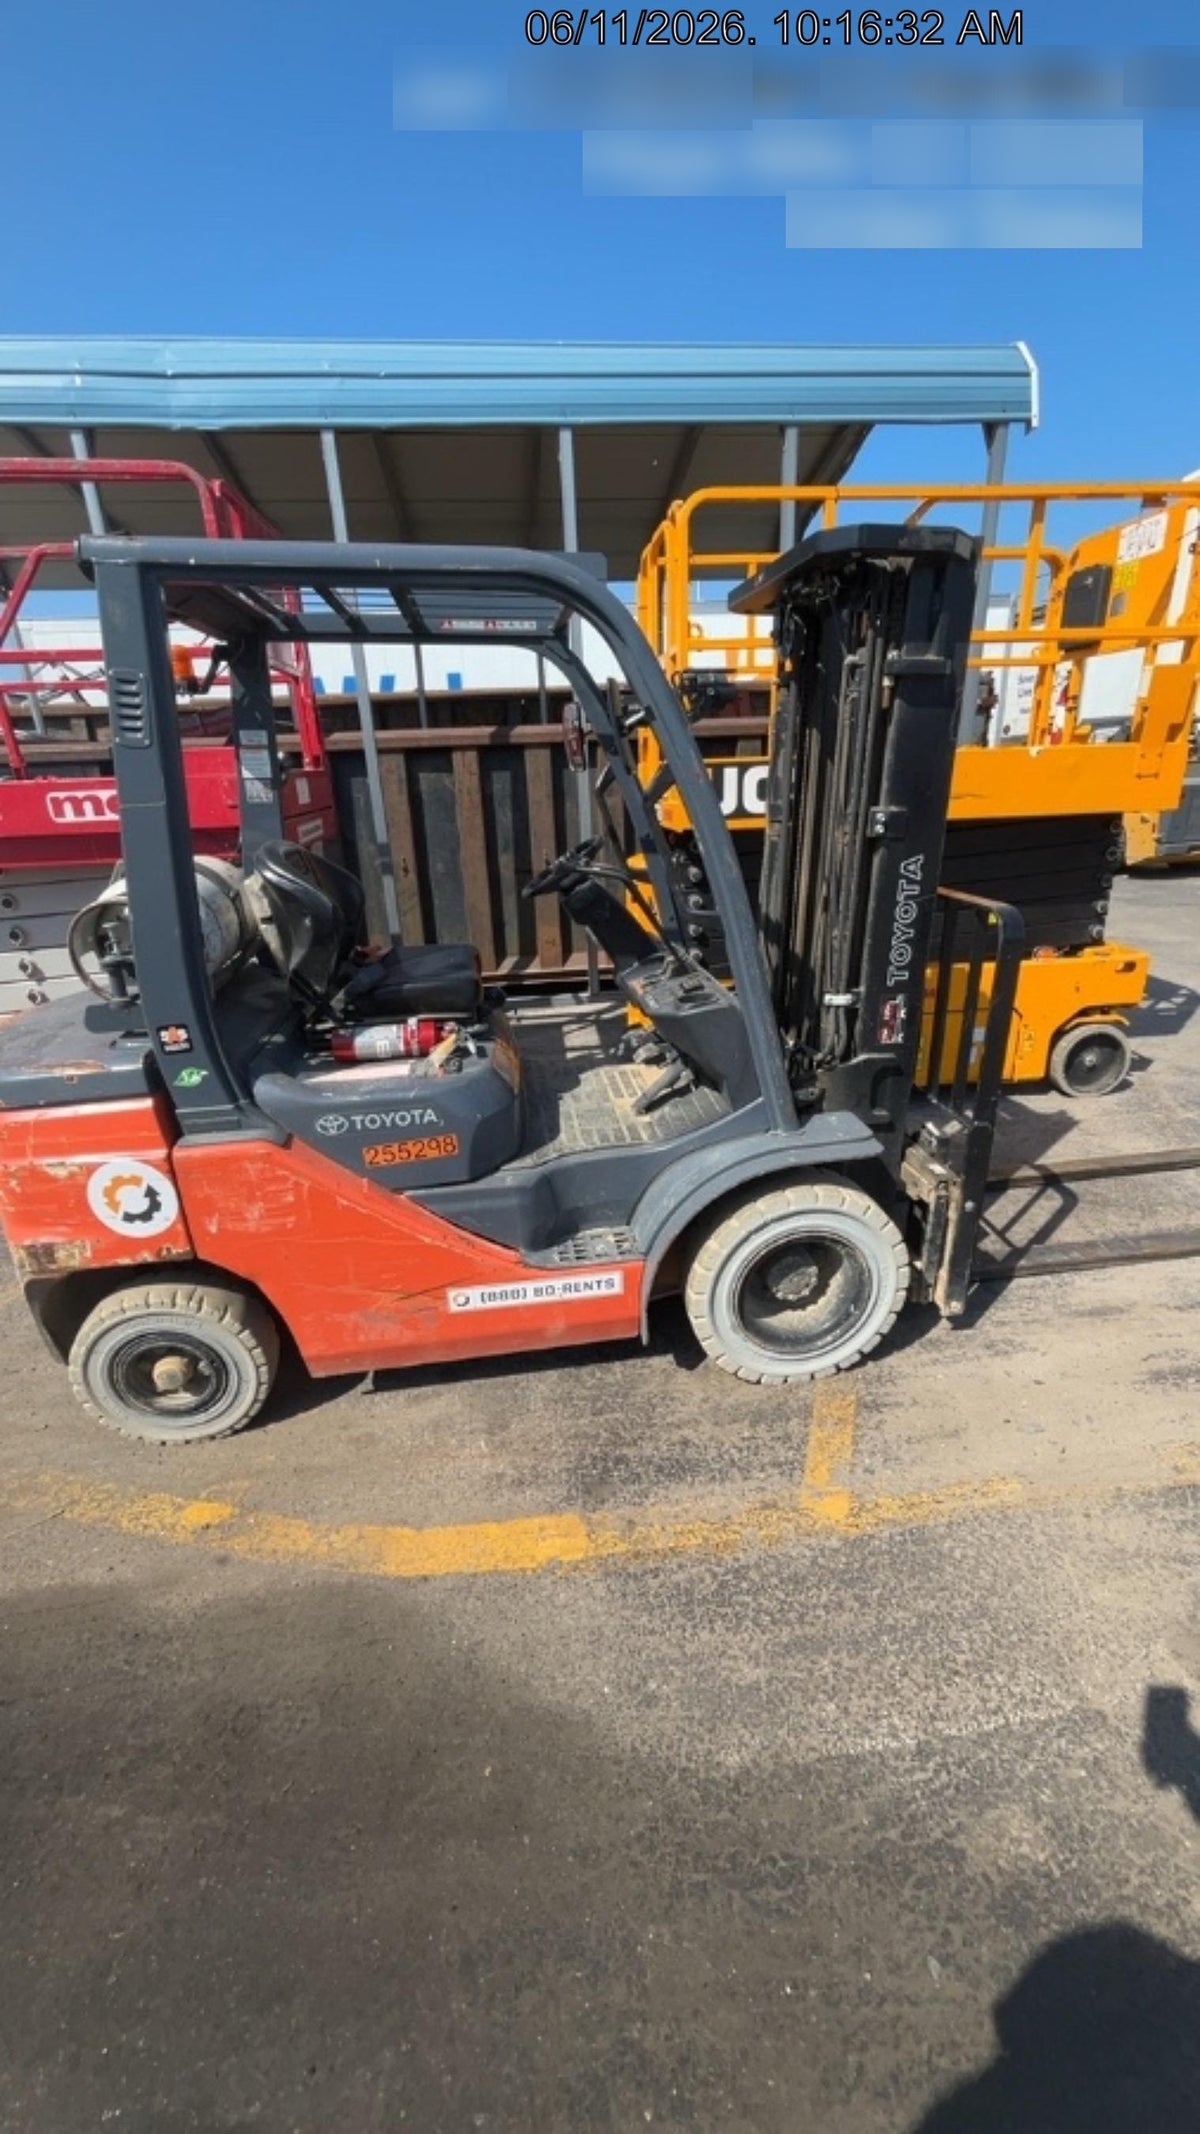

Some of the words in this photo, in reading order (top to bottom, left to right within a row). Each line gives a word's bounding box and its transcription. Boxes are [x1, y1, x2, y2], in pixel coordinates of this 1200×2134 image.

[886, 853, 925, 988] TOYOTA
[350, 1108, 438, 1131] TOYOTA
[366, 1135, 457, 1166] 255298
